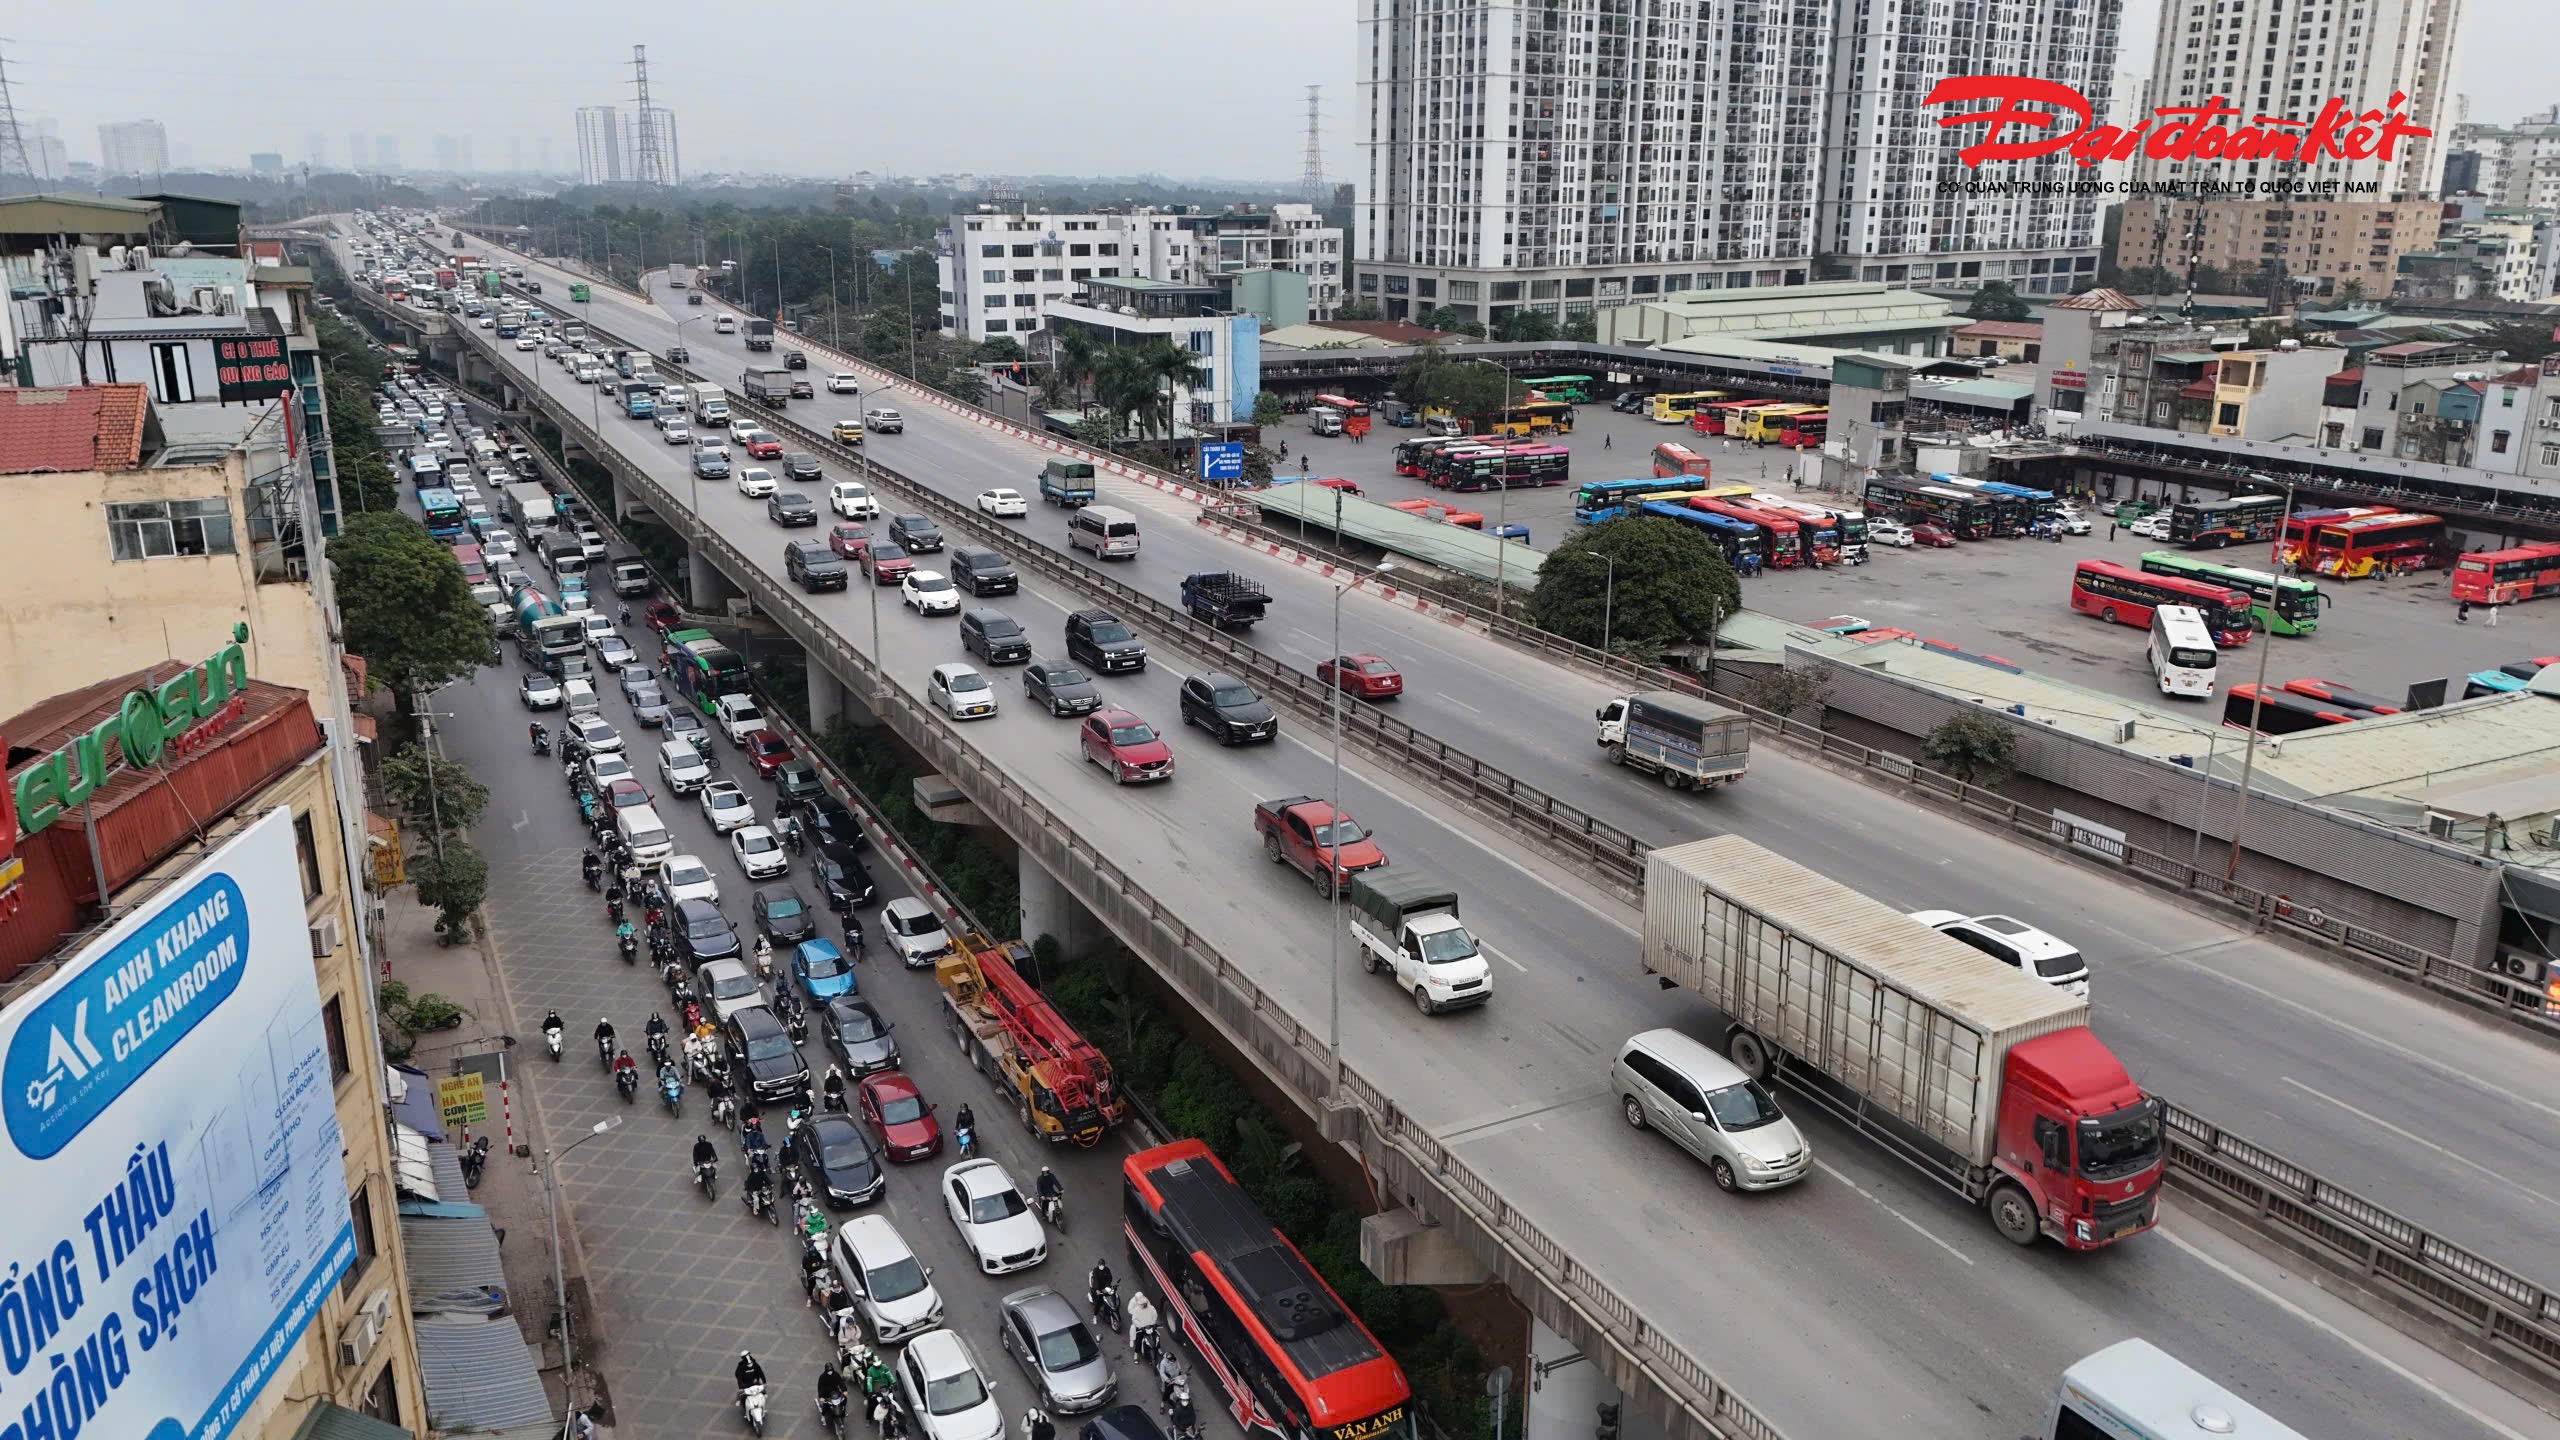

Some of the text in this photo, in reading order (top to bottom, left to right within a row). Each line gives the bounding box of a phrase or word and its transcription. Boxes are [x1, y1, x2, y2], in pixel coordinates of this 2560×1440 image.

[248, 337, 280, 357] THUÊ
[263, 361, 289, 380] CÁO
[104, 888, 230, 1013] ANH KHANG
[111, 934, 238, 1063] CLEANROOM
[275, 1072, 314, 1119] CLEAN ROOM
[287, 1067, 300, 1084] ISO
[263, 1116, 301, 1162] GMP-WHO
[0, 1139, 175, 1391] ỔNG THẦU
[0, 1207, 218, 1440] HÒNG SẠCH
[1333, 1407, 1404, 1440] VÂN ANH
